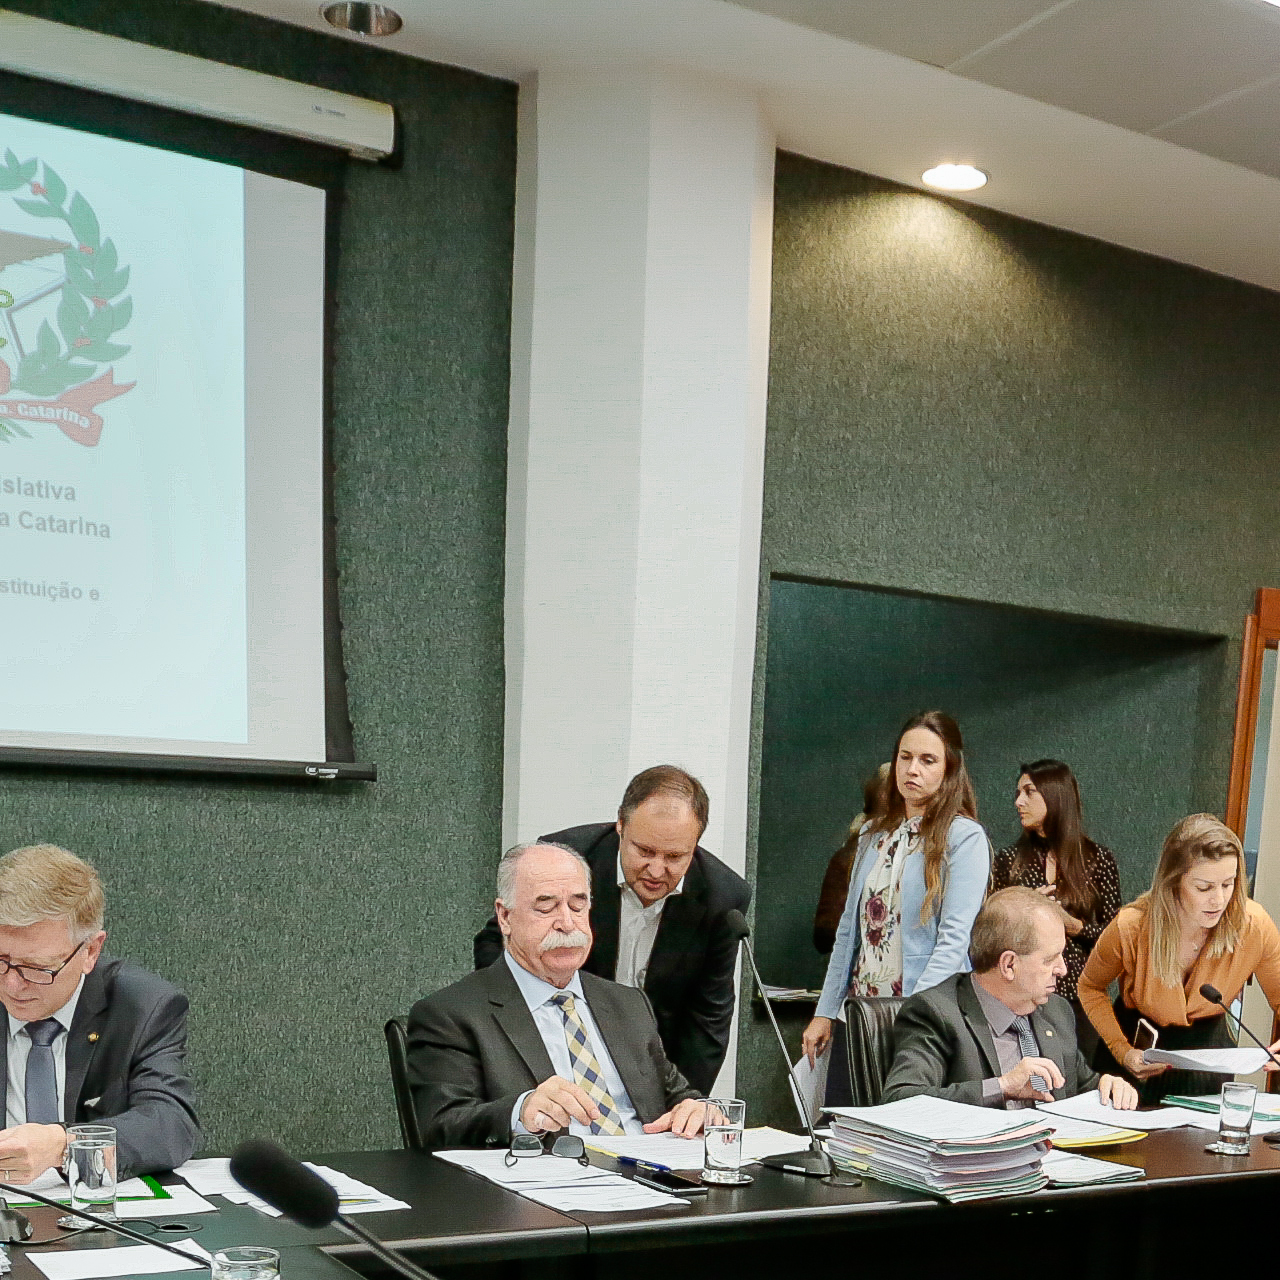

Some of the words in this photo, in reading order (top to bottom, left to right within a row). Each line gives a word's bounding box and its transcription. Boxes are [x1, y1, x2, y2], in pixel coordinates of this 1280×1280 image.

[17, 403, 91, 428] Catarina
[19, 509, 112, 539] Catarina
[89, 587, 101, 602] e
